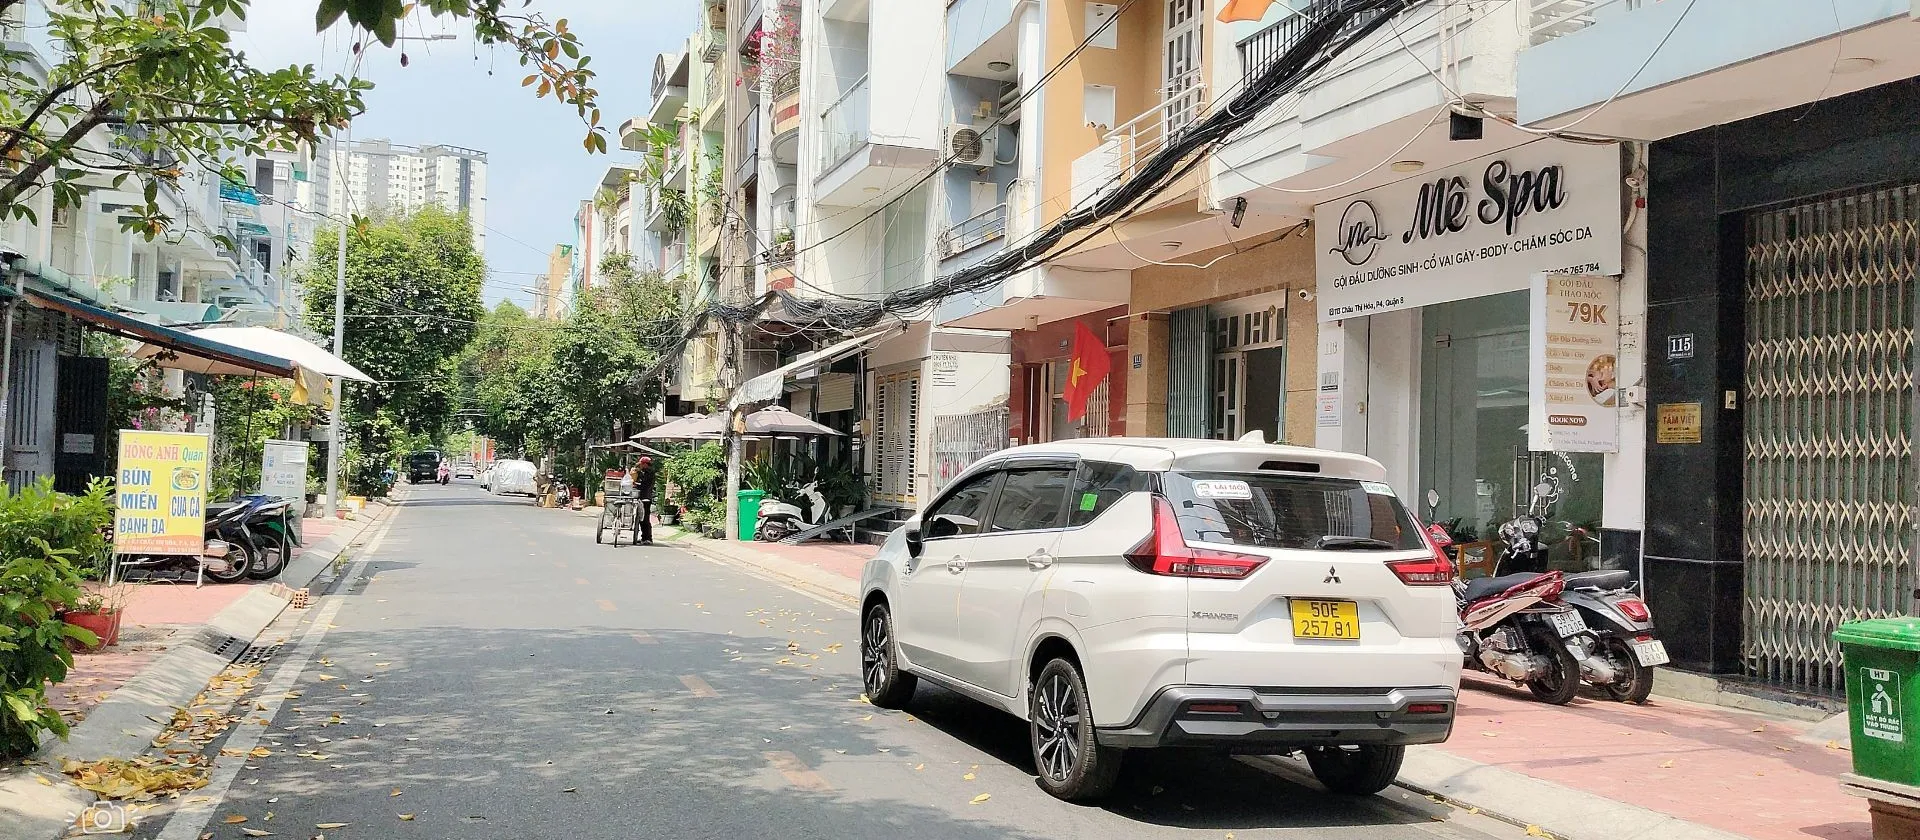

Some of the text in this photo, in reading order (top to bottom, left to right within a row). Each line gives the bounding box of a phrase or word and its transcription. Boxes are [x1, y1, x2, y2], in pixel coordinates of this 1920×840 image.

[1402, 159, 1567, 244] Mê Spa
[1439, 255, 1454, 268] VAI
[1549, 228, 1573, 246] SÓC
[1576, 226, 1593, 241] DA
[1569, 264, 1584, 274] 765
[1584, 262, 1600, 273] 784
[1567, 301, 1608, 325] 79K
[1671, 337, 1691, 352] 115
[155, 446, 179, 460] ANH
[122, 466, 152, 486] BÚN
[120, 488, 157, 510] MIẾN
[171, 496, 187, 517] CUA
[151, 517, 165, 534] ĐA
[1311, 601, 1340, 618] 50E
[1301, 619, 1352, 637] 257.81
[1873, 671, 1885, 679] HT
